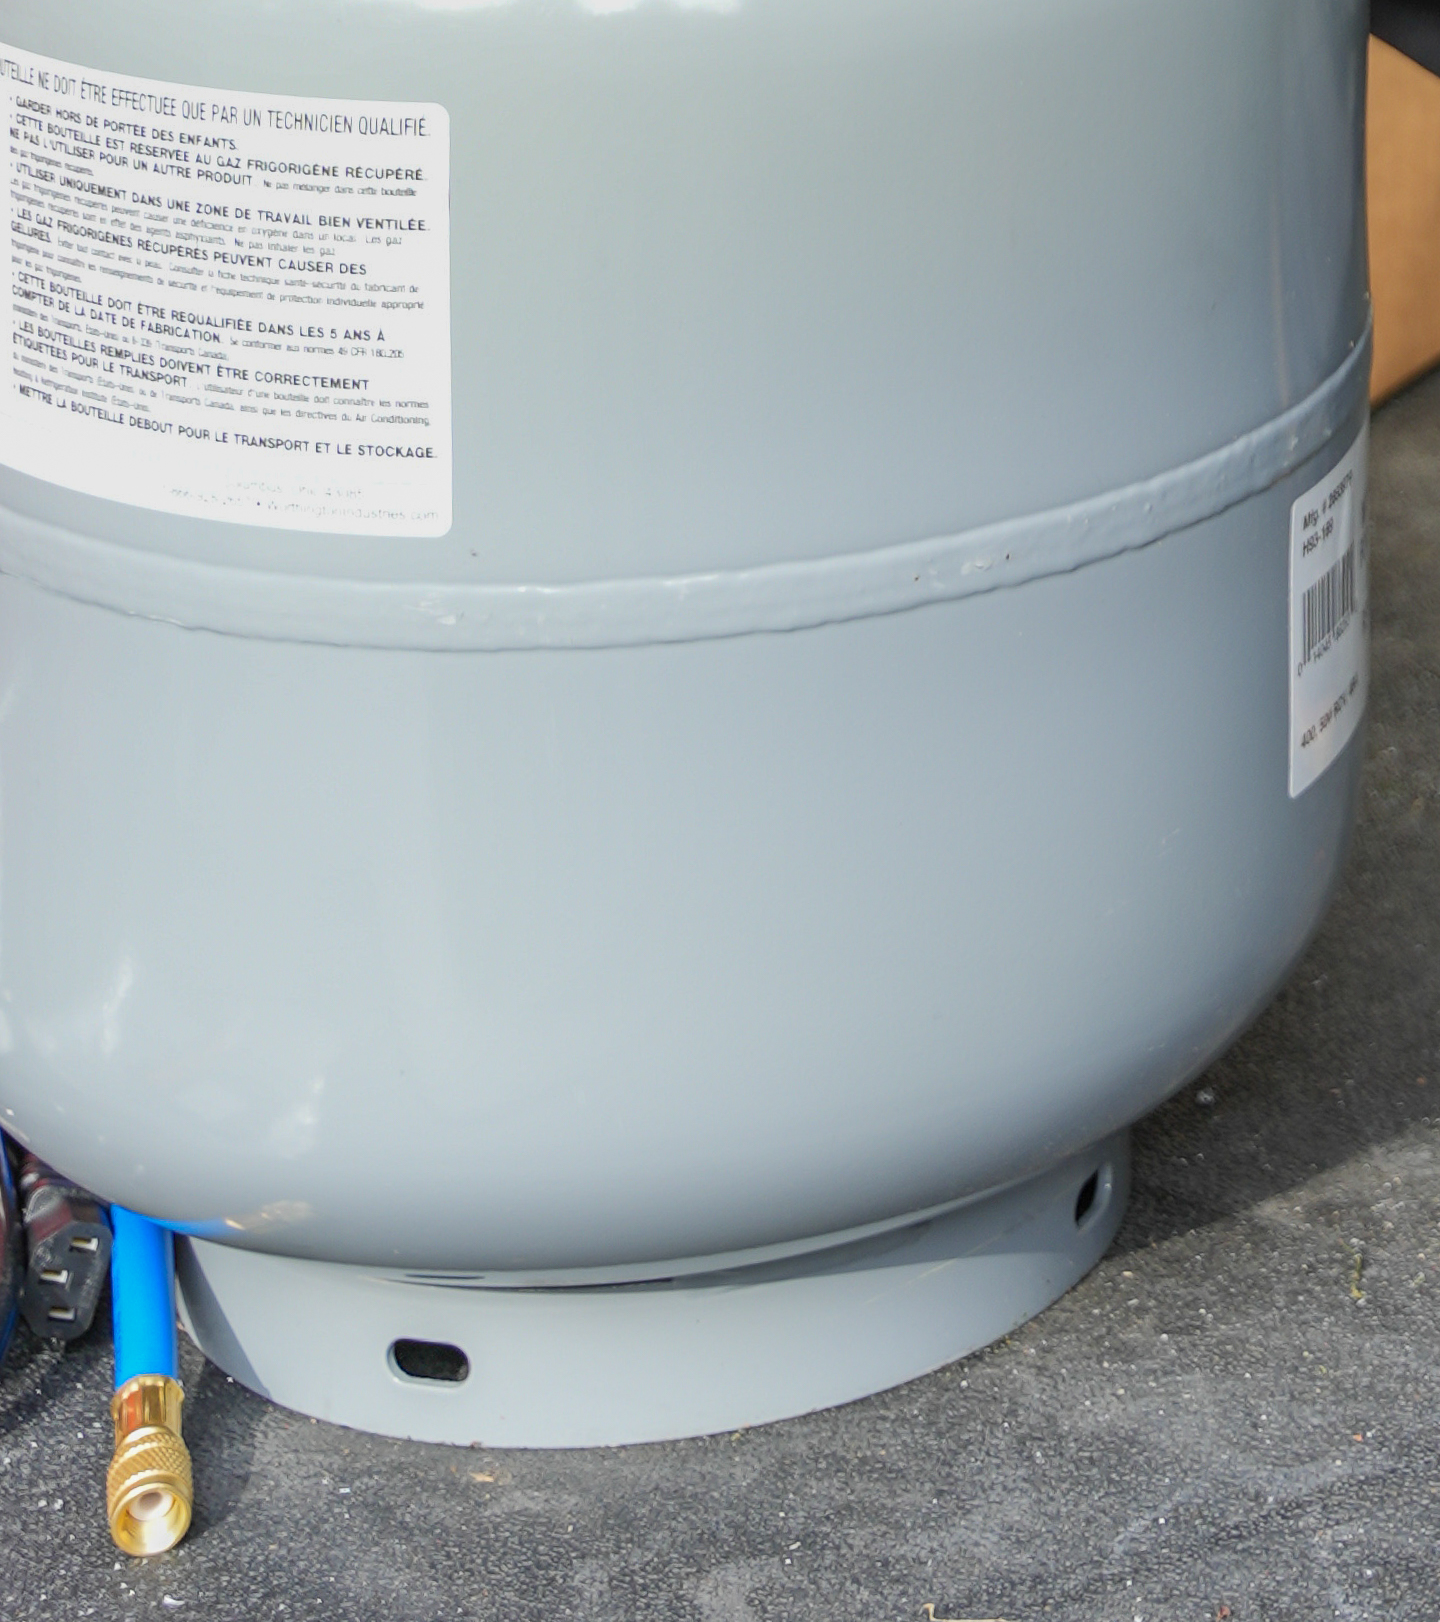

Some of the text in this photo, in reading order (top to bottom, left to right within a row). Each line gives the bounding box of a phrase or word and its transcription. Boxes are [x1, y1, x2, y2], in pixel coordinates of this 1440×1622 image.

[15, 95, 236, 150] GARDER HORS DE PORTÉE DES ENFANTS.
[38, 70, 49, 90] NE
[53, 74, 76, 94] DOIT
[80, 80, 106, 104] ÊTRE
[182, 100, 205, 120] QUE
[212, 103, 237, 123] PAR
[243, 108, 261, 126] UN
[267, 109, 352, 133] TECHNICIEN
[358, 116, 425, 136] QUALIFIÉ.
[9, 126, 19, 139] NE
[23, 131, 39, 145] PAS
[43, 140, 94, 159] L'UTILISER
[99, 151, 127, 166] POUR
[133, 159, 147, 170] UN
[153, 163, 190, 178] AUTRE
[16, 113, 42, 131] CETTE
[47, 122, 100, 146] BOUTEILLE
[105, 136, 124, 149] EST
[195, 153, 210, 165] AU
[216, 155, 240, 168] GAZ
[16, 162, 54, 182] UTILISER
[59, 176, 126, 198] UNIQUEMENT
[132, 191, 161, 207] DANS
[167, 199, 189, 212] UNE
[195, 202, 228, 217] ZONE
[234, 207, 250, 220] DE
[257, 209, 311, 225] TRAVAIL
[318, 215, 350, 227] BIEN
[356, 217, 425, 231] VENTILÉE.
[17, 208, 31, 221] LES
[35, 213, 52, 228] GAZ
[213, 251, 271, 267] PEUVENT
[278, 258, 333, 272] CAUSER
[339, 262, 366, 275] DES
[12, 284, 53, 307] COMPTER
[58, 299, 69, 312] DE
[74, 306, 85, 316] LA
[90, 308, 116, 324] DATE
[122, 315, 135, 328] DE
[140, 319, 220, 343] FABRICATION.
[18, 270, 45, 289] CETTE
[49, 281, 102, 305] BOUTEILLE
[107, 296, 131, 310] DOIT
[137, 302, 165, 318] ÊTRE
[258, 321, 293, 335] DANS
[299, 326, 324, 338] LES
[330, 328, 337, 339] 5
[343, 329, 370, 341] ANS
[376, 329, 384, 341] À
[19, 320, 368, 390] LES BOUTEILLES REMPLIES DOIVENT ÊTRE CORRECTEMENT
[71, 352, 98, 368] POUR
[102, 361, 114, 373] LE
[19, 383, 433, 458] METTRE LA BOUTEILLE DEBOUT POUR LE TRANSPORT ET LE STOCKAGE.
